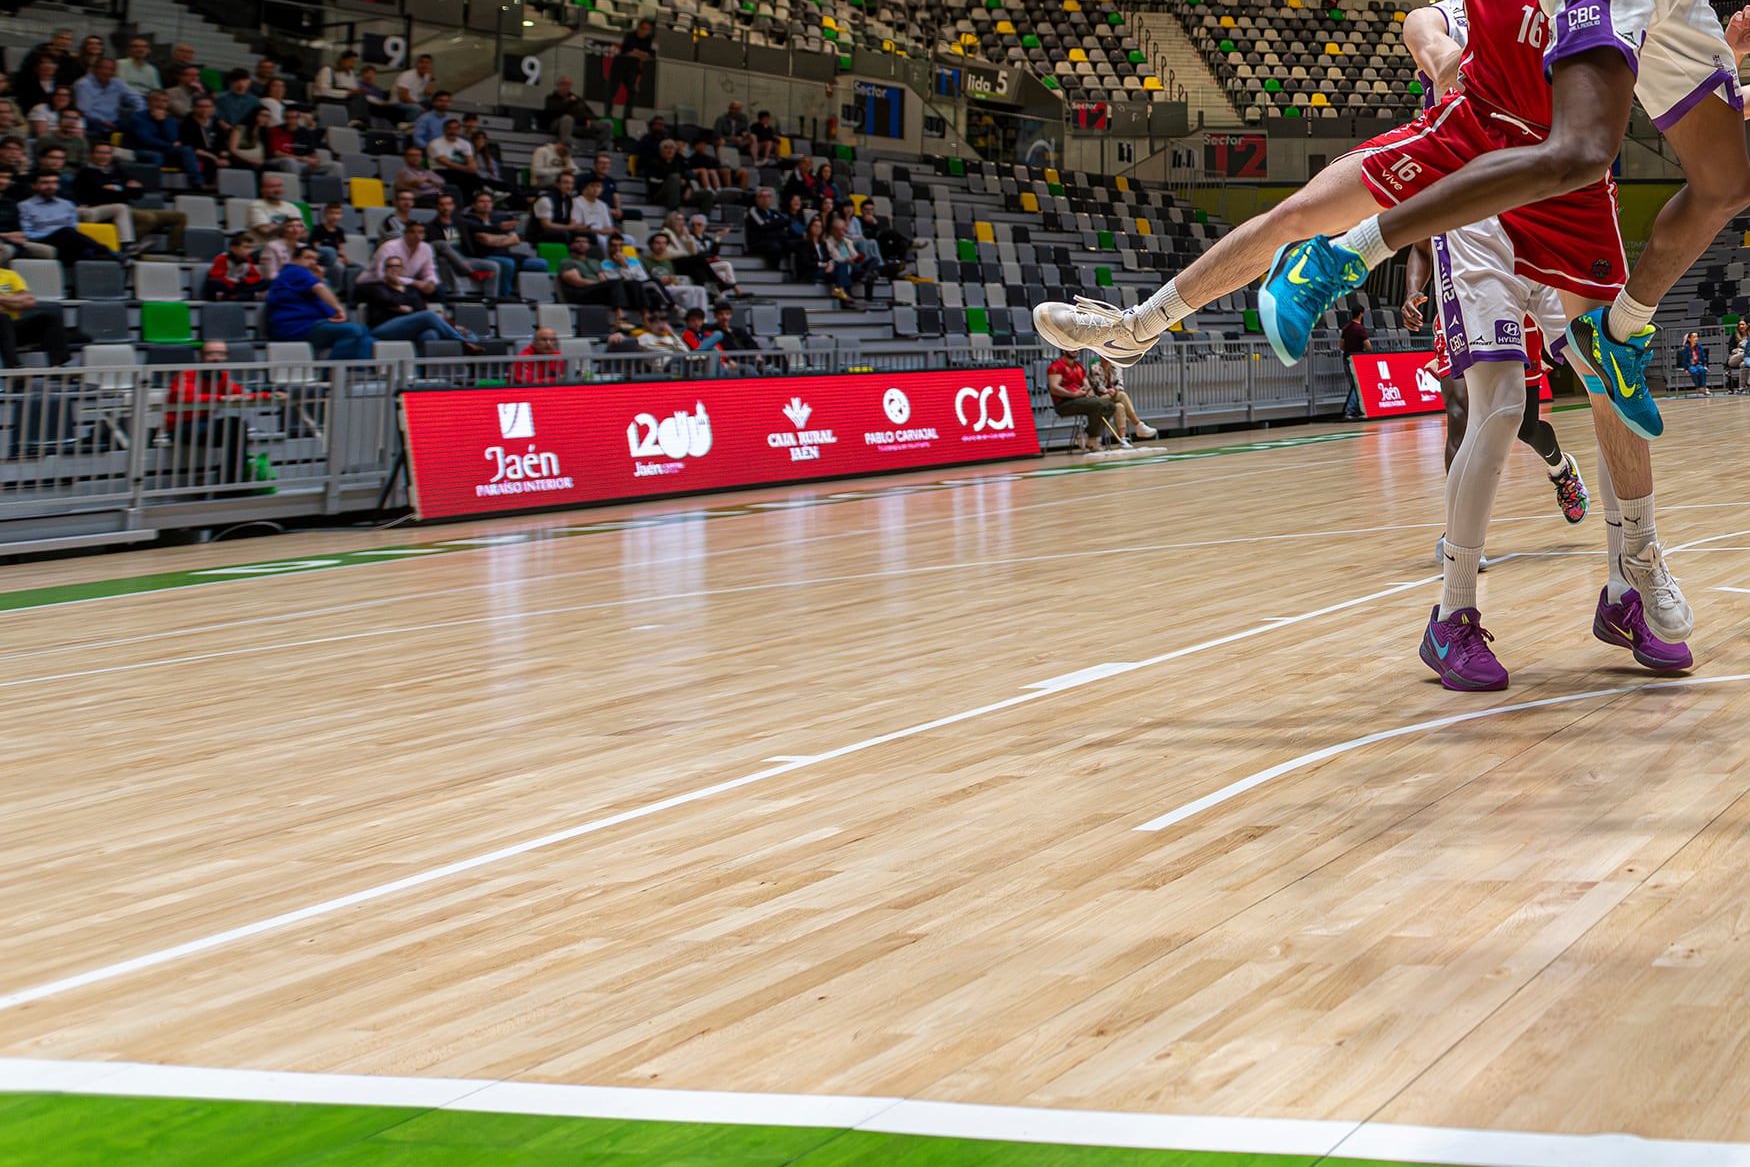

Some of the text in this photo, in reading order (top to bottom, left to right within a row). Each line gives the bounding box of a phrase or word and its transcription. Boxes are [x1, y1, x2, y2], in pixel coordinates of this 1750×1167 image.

[1517, 5, 1545, 48] 16
[1568, 6, 1600, 27] CBC
[383, 36, 406, 68] 9
[584, 38, 618, 58] Sect
[520, 56, 541, 86] 9
[854, 81, 887, 98] Sector
[995, 70, 1008, 95] 5
[1204, 134, 1243, 146] Sector
[1215, 134, 1267, 178] 12
[1390, 153, 1422, 182] 16
[1381, 170, 1403, 191] vive
[1449, 333, 1465, 352] CBC
[767, 430, 837, 448] CAJA RURAL
[864, 428, 939, 445] PABLO CARVAJAL
[484, 444, 560, 483] Jaén
[790, 445, 820, 462] JAÉN
[633, 461, 663, 477] Jaén
[524, 477, 574, 493] INTERIOR
